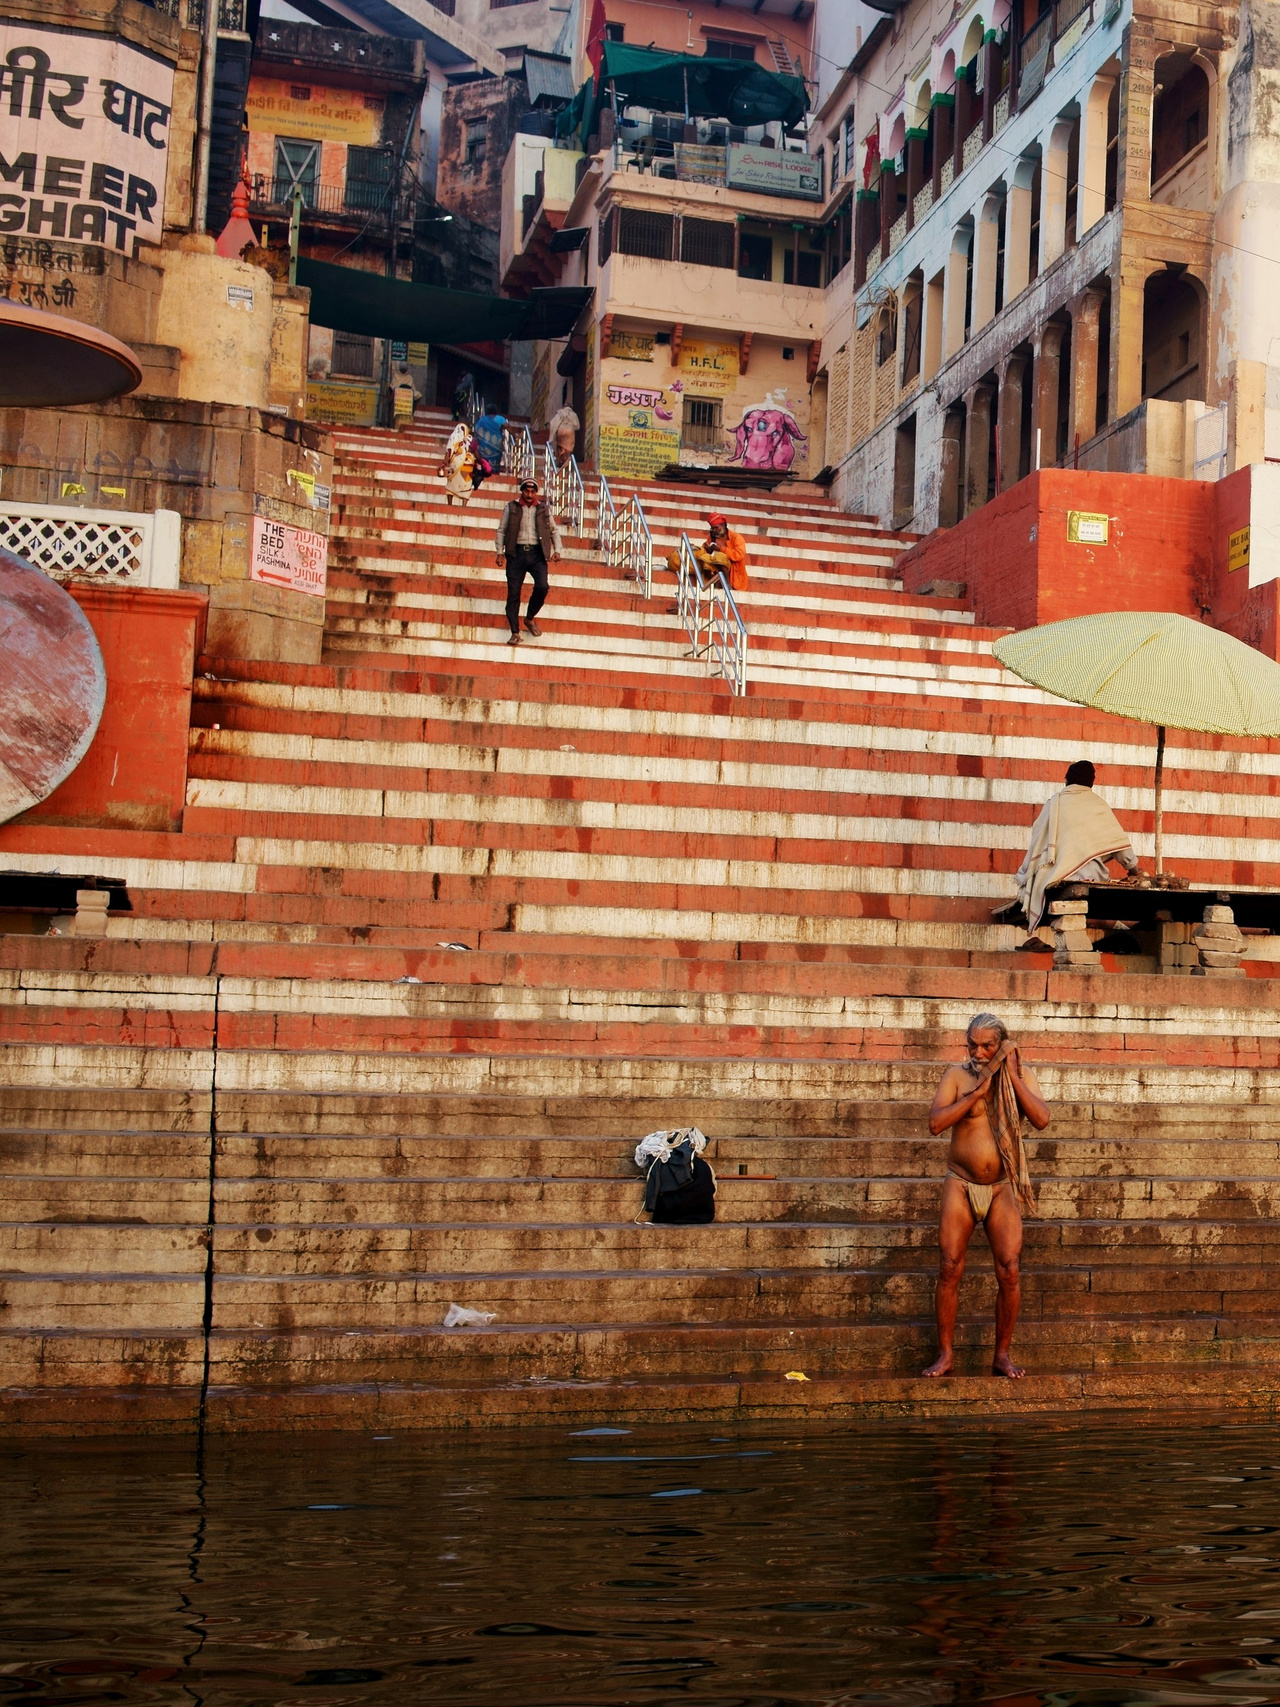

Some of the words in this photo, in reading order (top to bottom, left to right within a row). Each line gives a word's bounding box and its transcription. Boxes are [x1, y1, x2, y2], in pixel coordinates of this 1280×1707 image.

[99, 78, 172, 150] घाट
[785, 164, 814, 174] LODGE
[0, 151, 157, 224] MEER
[0, 193, 137, 251] GHAT
[690, 356, 725, 371] H.F.L.
[263, 521, 285, 538] THE
[260, 533, 285, 549] BED
[260, 545, 279, 558] SILK
[256, 554, 291, 571] PASHMINA
